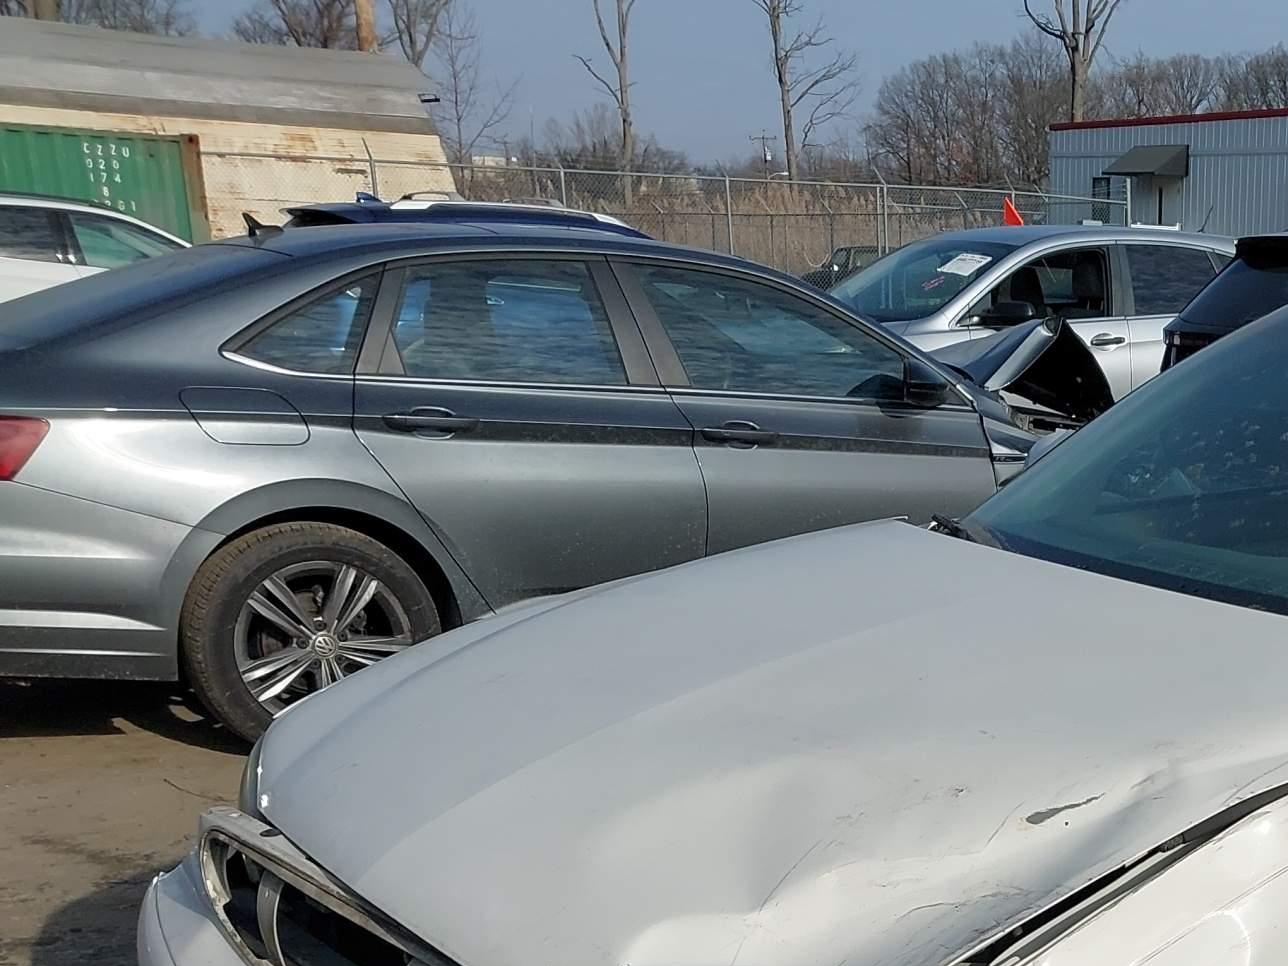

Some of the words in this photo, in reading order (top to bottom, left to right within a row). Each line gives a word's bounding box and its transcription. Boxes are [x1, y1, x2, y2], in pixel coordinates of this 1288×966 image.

[86, 158, 120, 170] 020
[89, 172, 122, 183] 174
[102, 185, 111, 198] 8
